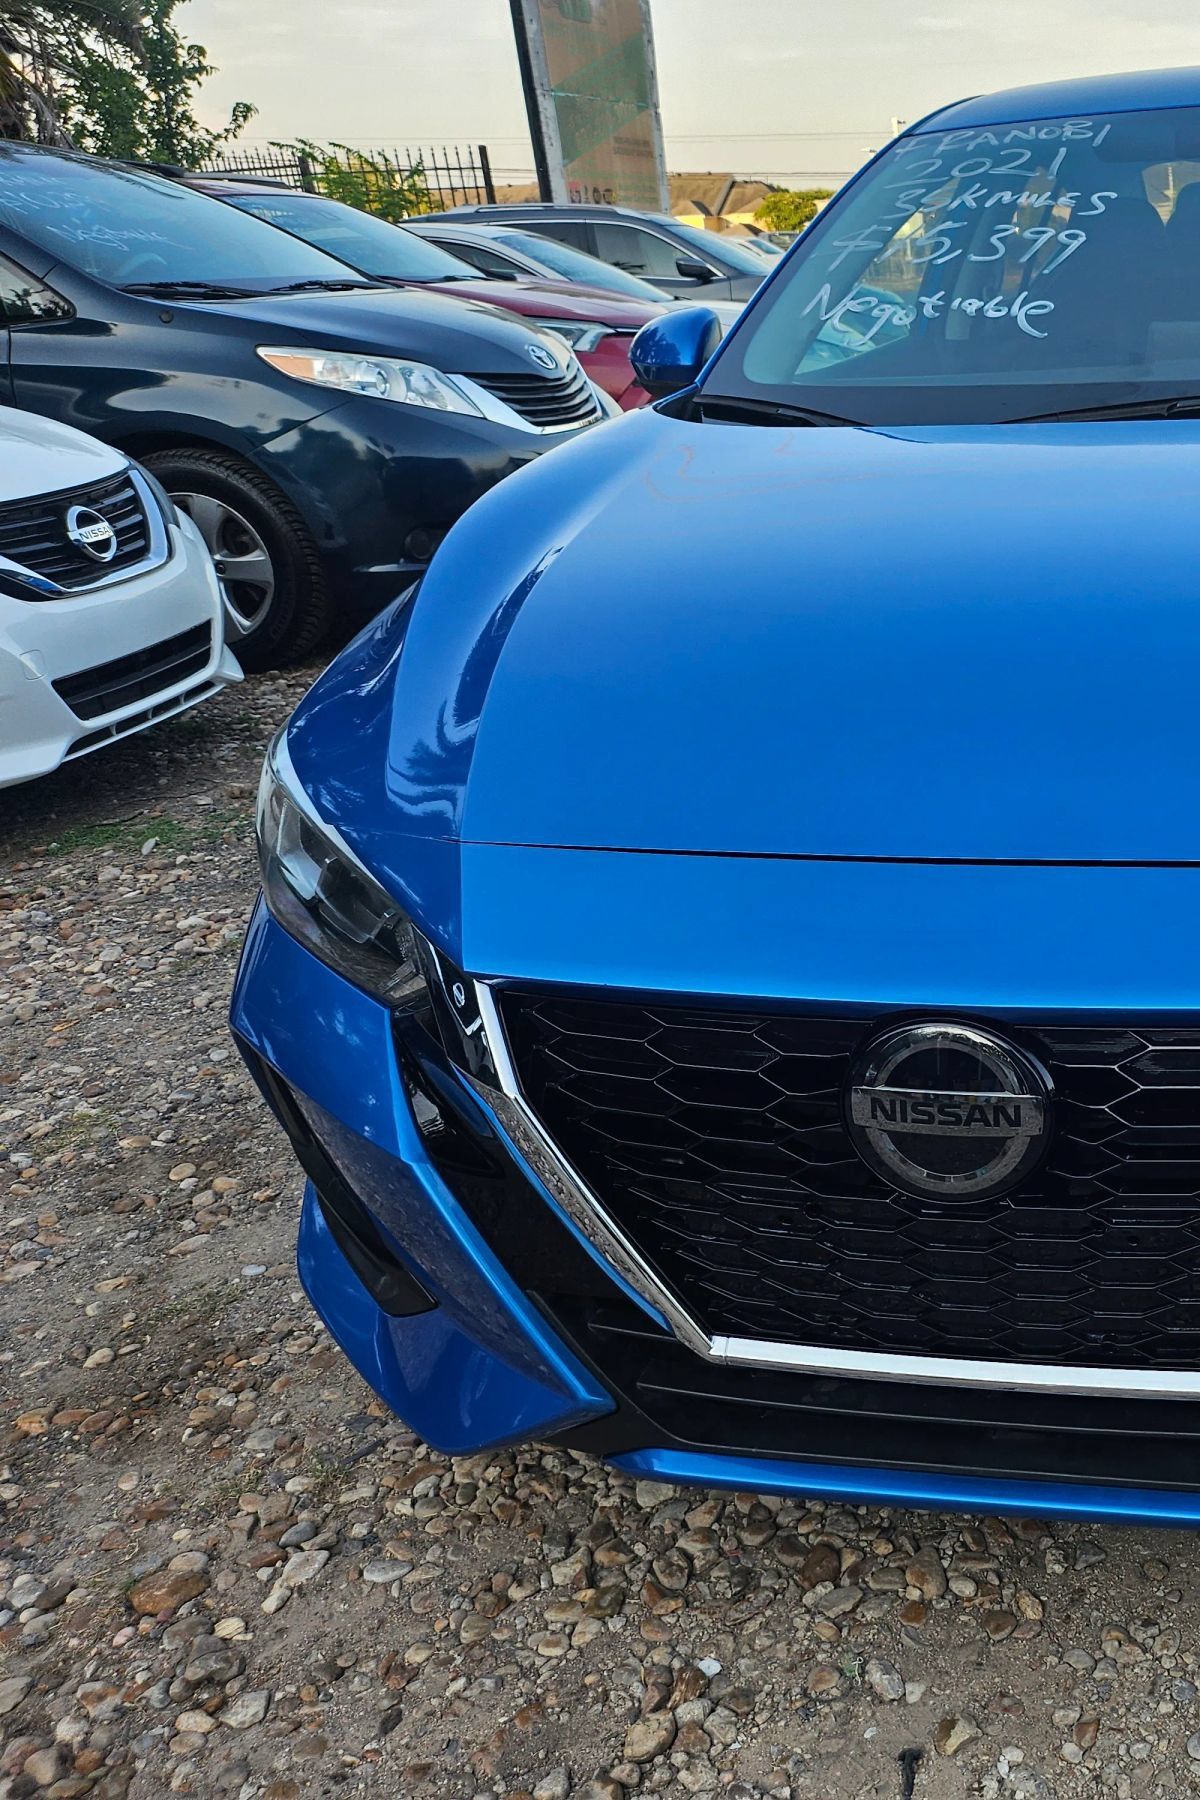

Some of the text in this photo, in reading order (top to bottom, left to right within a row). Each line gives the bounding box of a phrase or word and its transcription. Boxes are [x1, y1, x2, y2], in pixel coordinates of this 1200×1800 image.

[882, 146, 1068, 189] 2021
[800, 283, 1056, 347] Negotiable
[869, 1097, 1022, 1128] NISSAN
